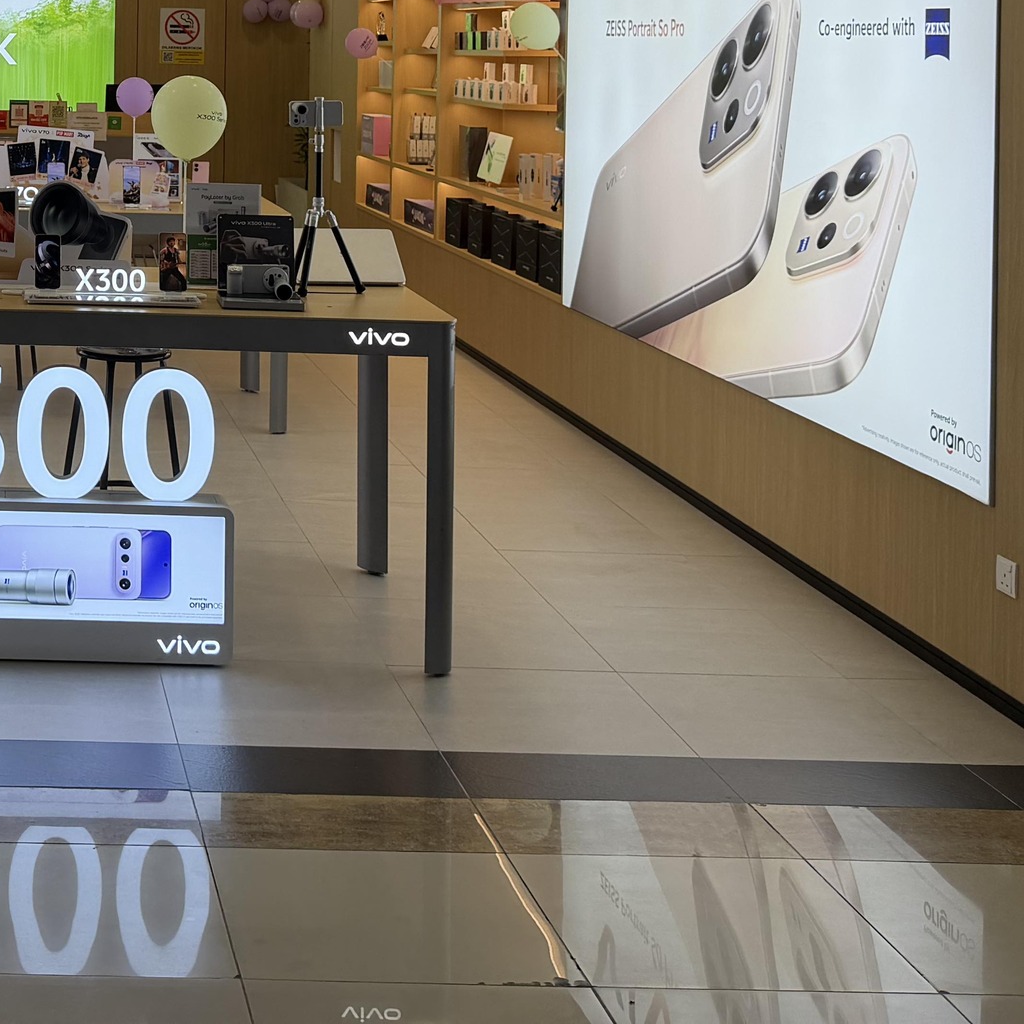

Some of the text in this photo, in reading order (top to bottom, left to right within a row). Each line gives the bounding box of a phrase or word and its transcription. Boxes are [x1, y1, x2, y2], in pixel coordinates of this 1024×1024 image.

[605, 19, 685, 37] ZEISS Portrait So Pro
[818, 18, 916, 40] Co-engineered with
[925, 21, 950, 36] ZEISS
[75, 268, 146, 292] X300
[348, 328, 410, 347] vivo
[931, 409, 957, 428] Powered by
[157, 635, 221, 655] vivo
